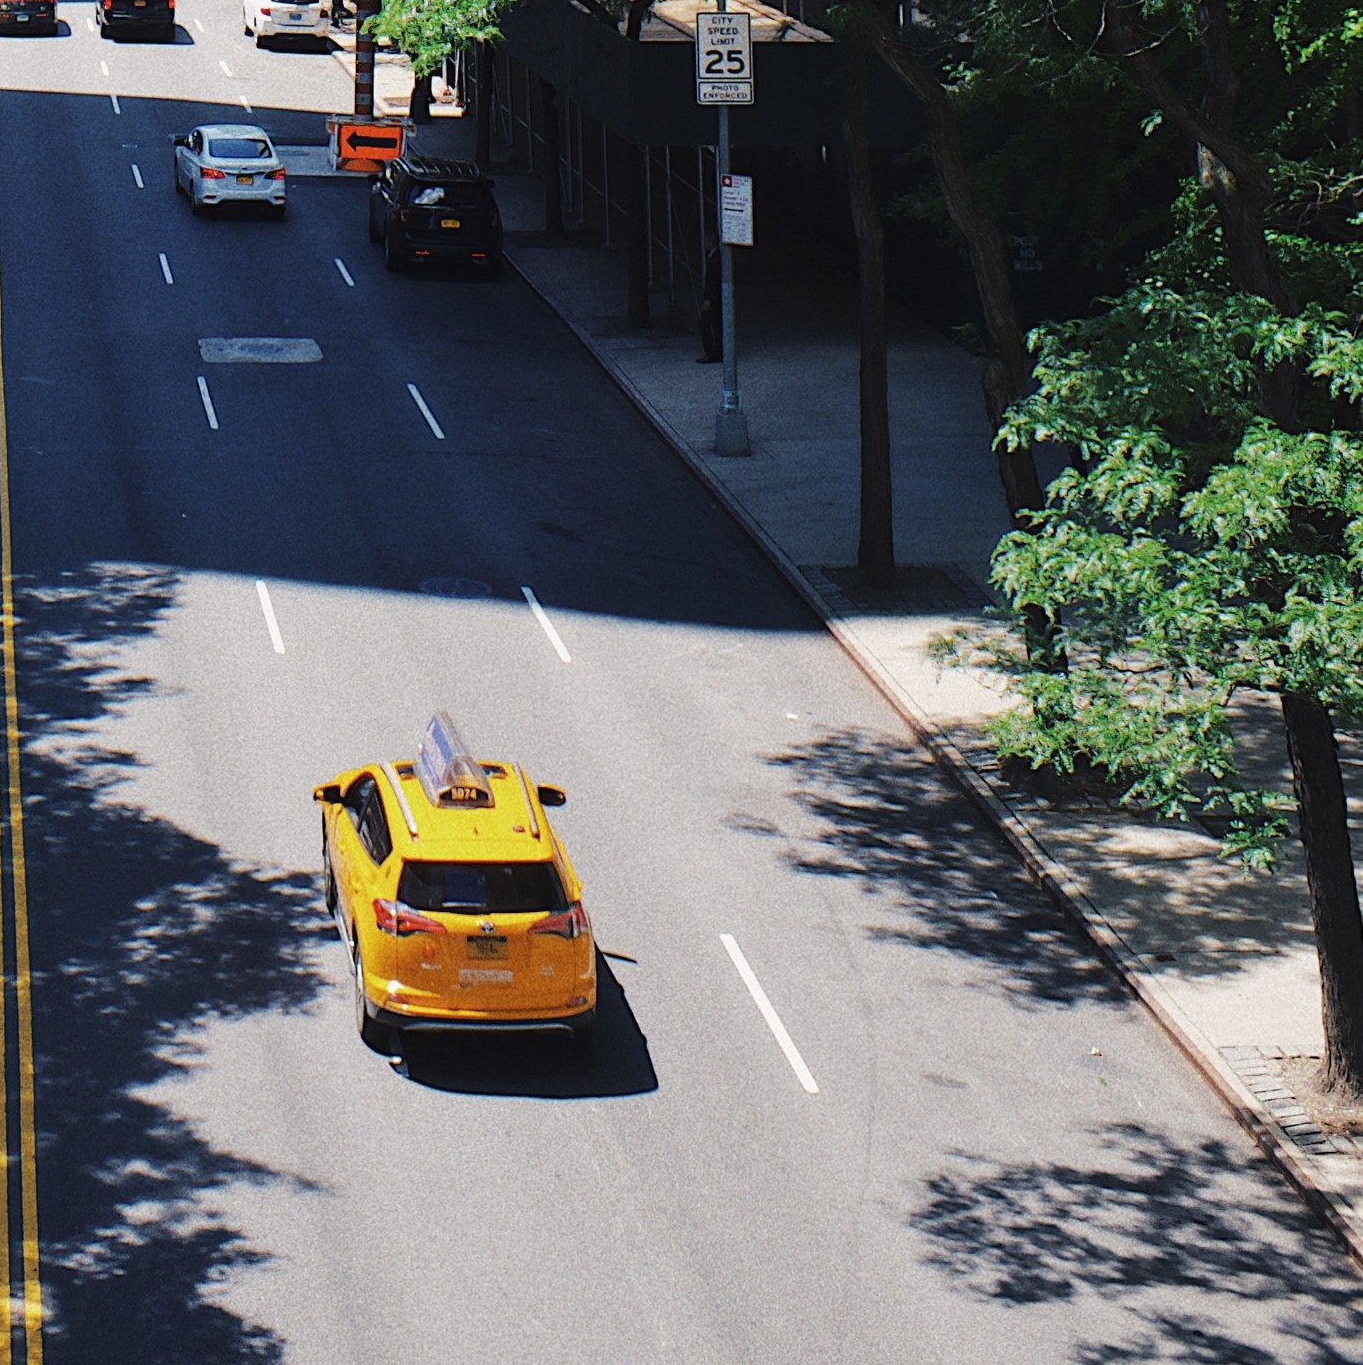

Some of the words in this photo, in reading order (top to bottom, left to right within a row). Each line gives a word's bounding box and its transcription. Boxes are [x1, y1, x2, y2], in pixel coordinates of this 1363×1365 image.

[711, 16, 733, 24] CITY
[707, 27, 739, 35] SPEED
[711, 38, 735, 46] LIMIT
[705, 49, 745, 74] 25
[703, 92, 748, 100] ENFORCED
